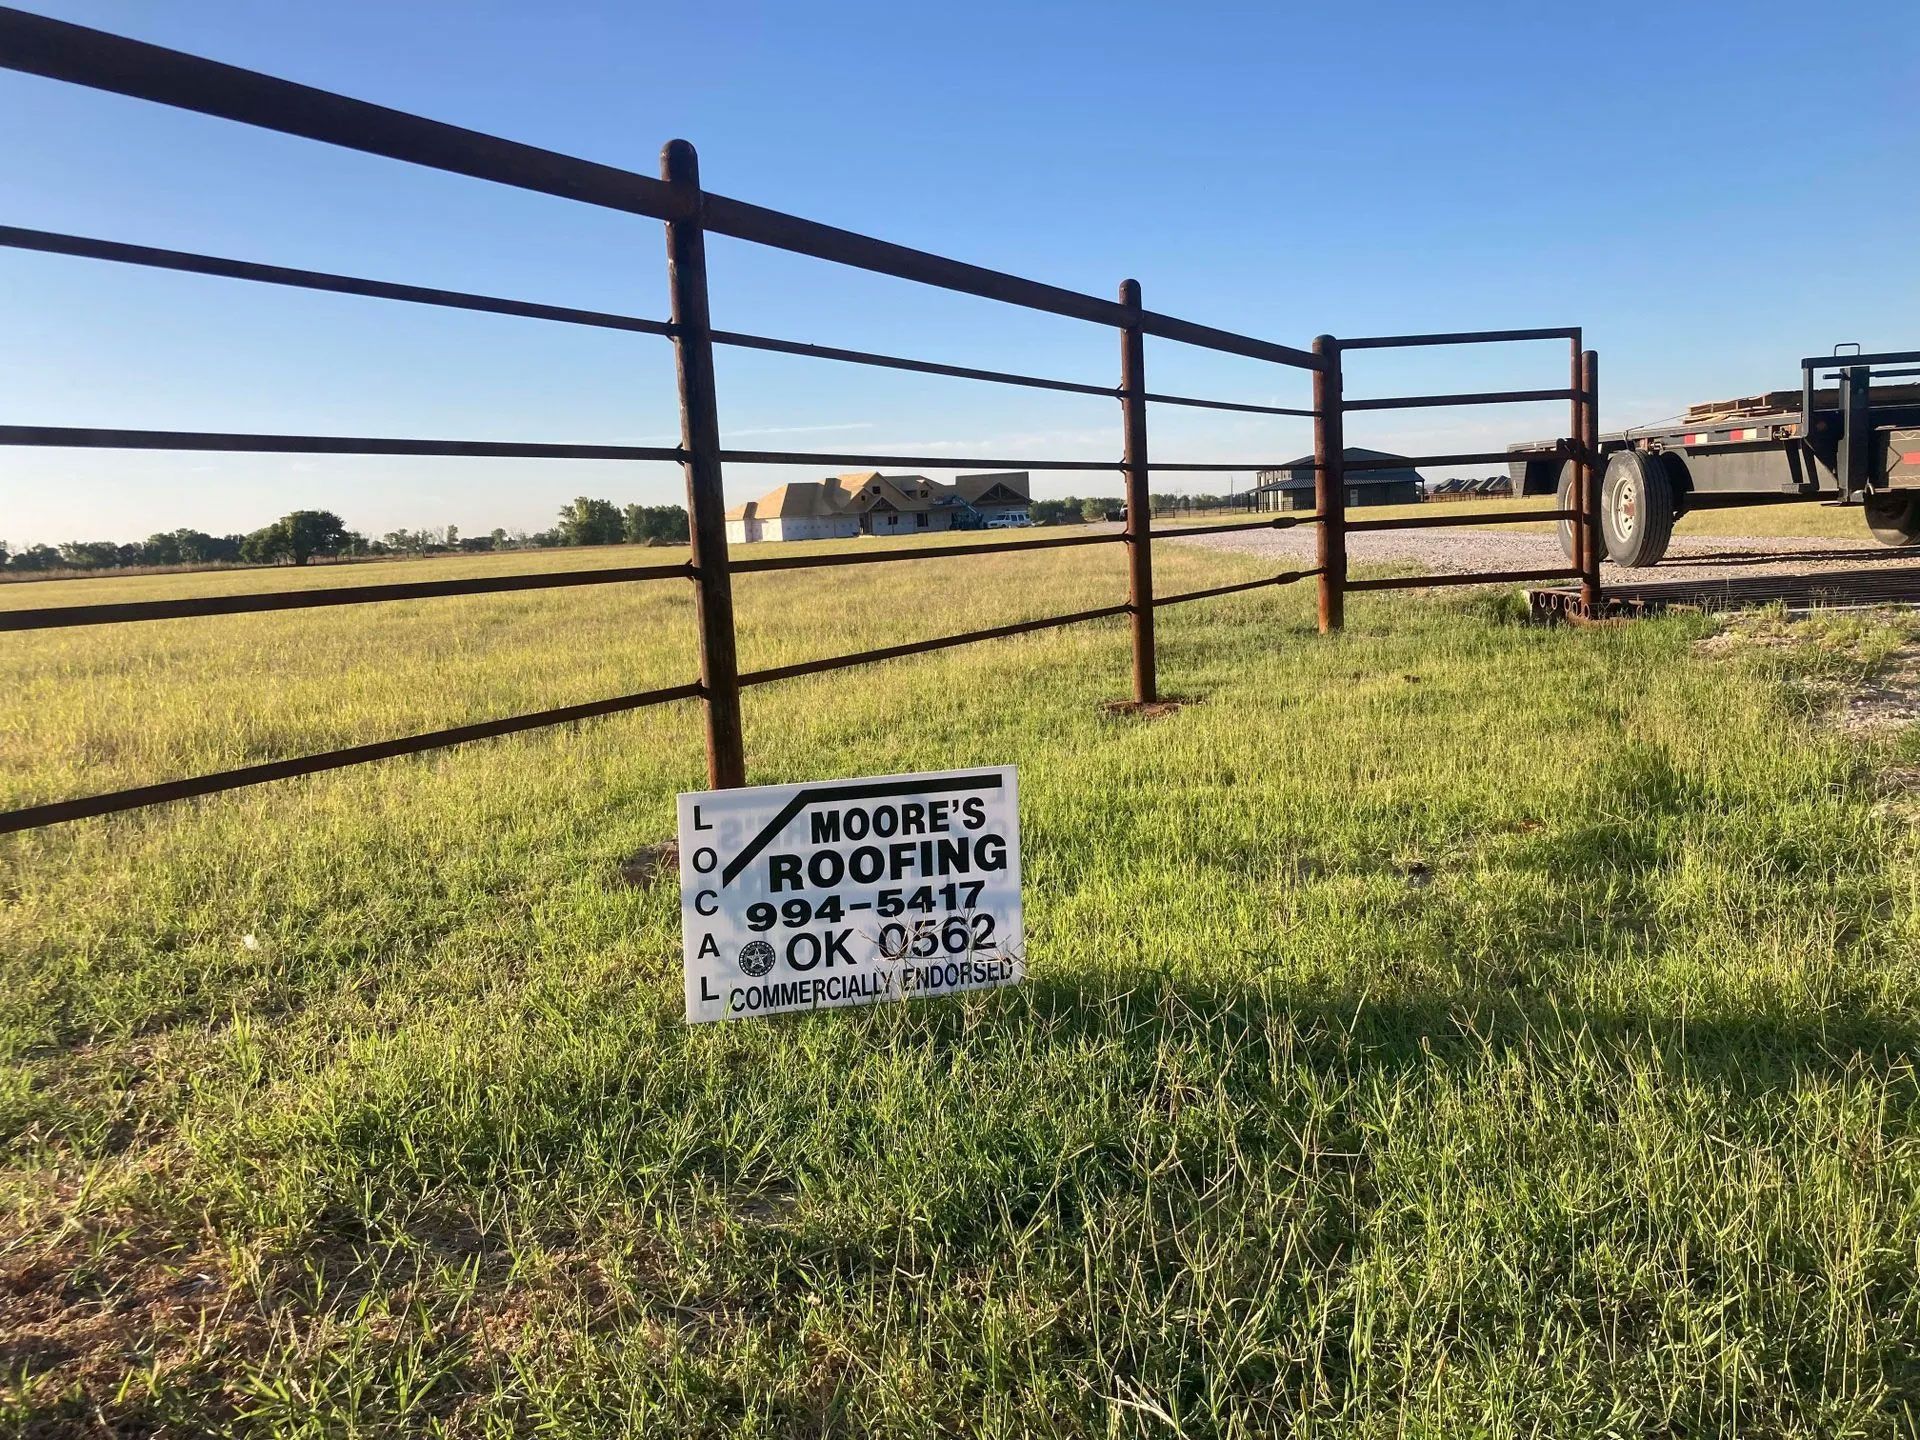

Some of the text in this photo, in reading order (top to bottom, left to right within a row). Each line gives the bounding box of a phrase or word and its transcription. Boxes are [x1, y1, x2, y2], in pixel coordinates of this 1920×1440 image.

[811, 797, 986, 845] MOORE'S
[769, 834, 1008, 893] ROOFING
[692, 805, 721, 1002] LOCAL
[746, 880, 986, 932] 994-5417
[786, 929, 858, 972] OK
[878, 913, 997, 960] 0562
[730, 957, 1013, 1012] COMMERCIALLY ENDORSED
